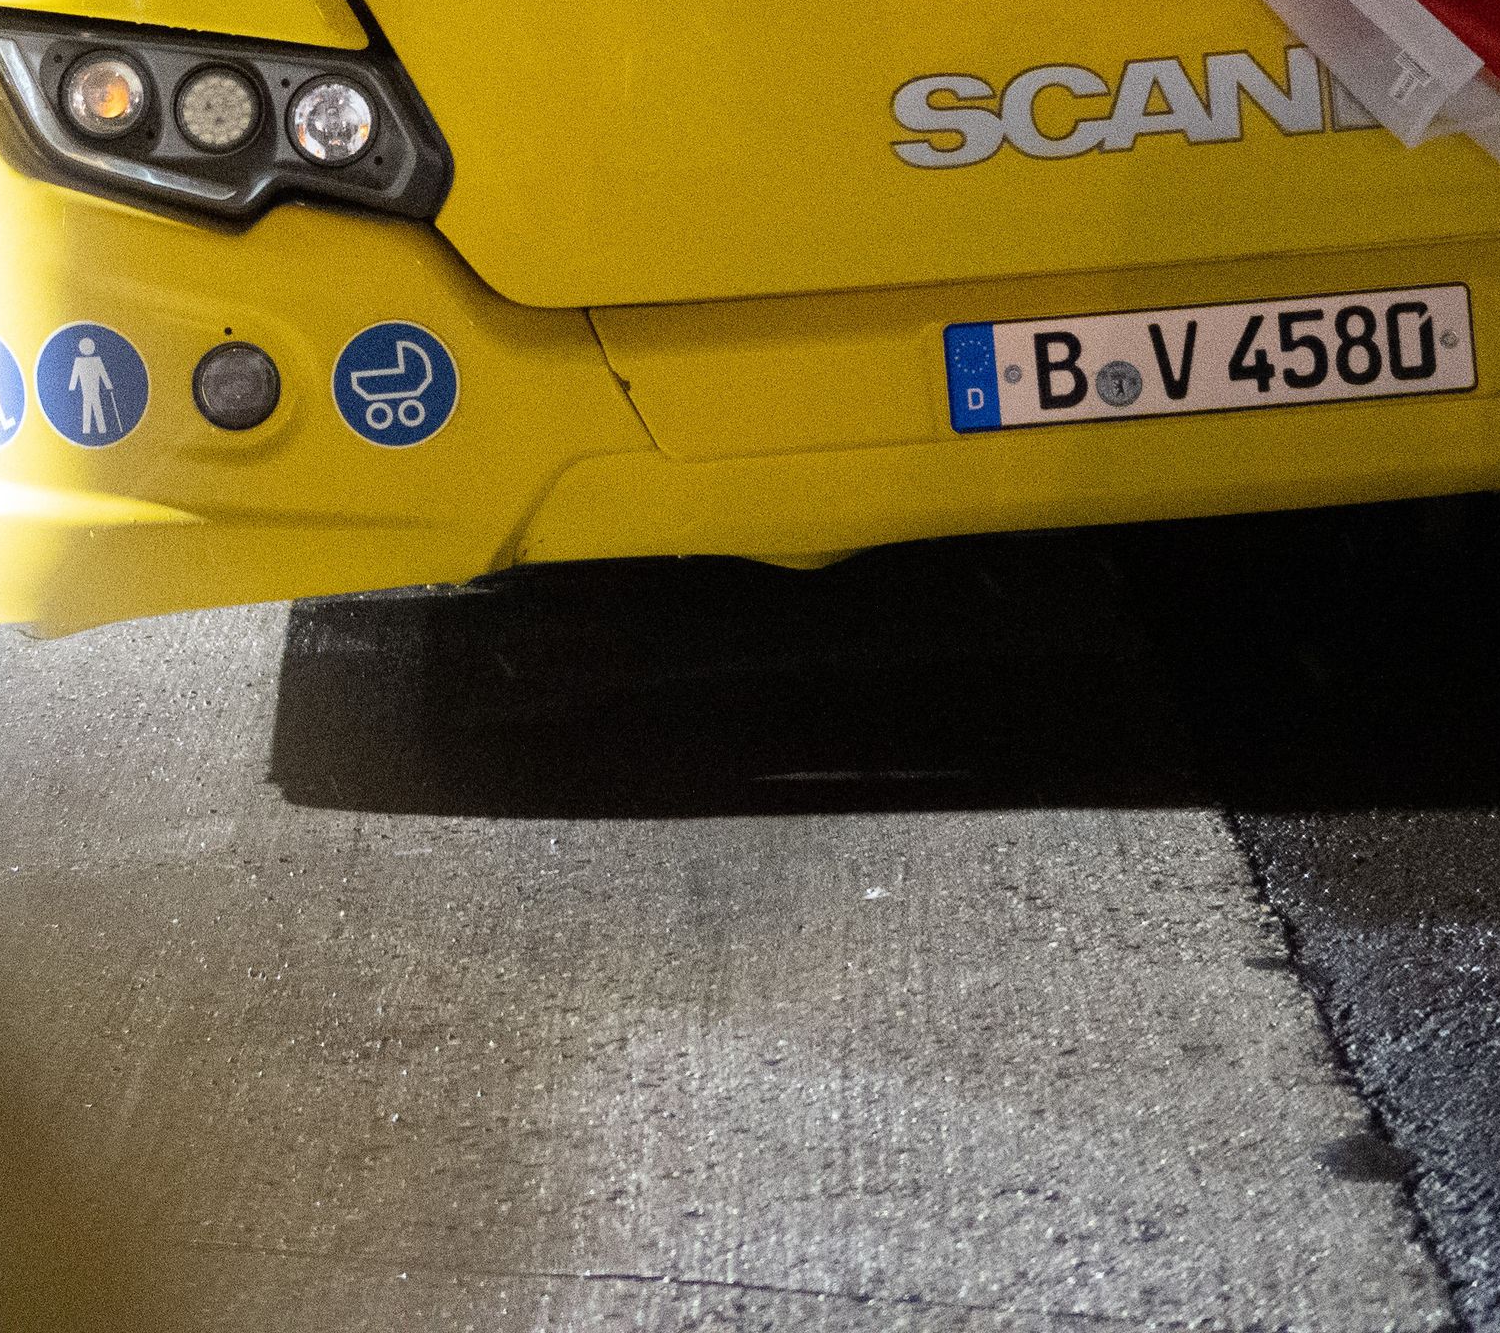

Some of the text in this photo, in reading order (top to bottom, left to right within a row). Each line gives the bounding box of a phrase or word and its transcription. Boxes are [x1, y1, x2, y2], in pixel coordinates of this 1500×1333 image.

[1033, 300, 1438, 411] B V 4580
[966, 386, 985, 410] D
